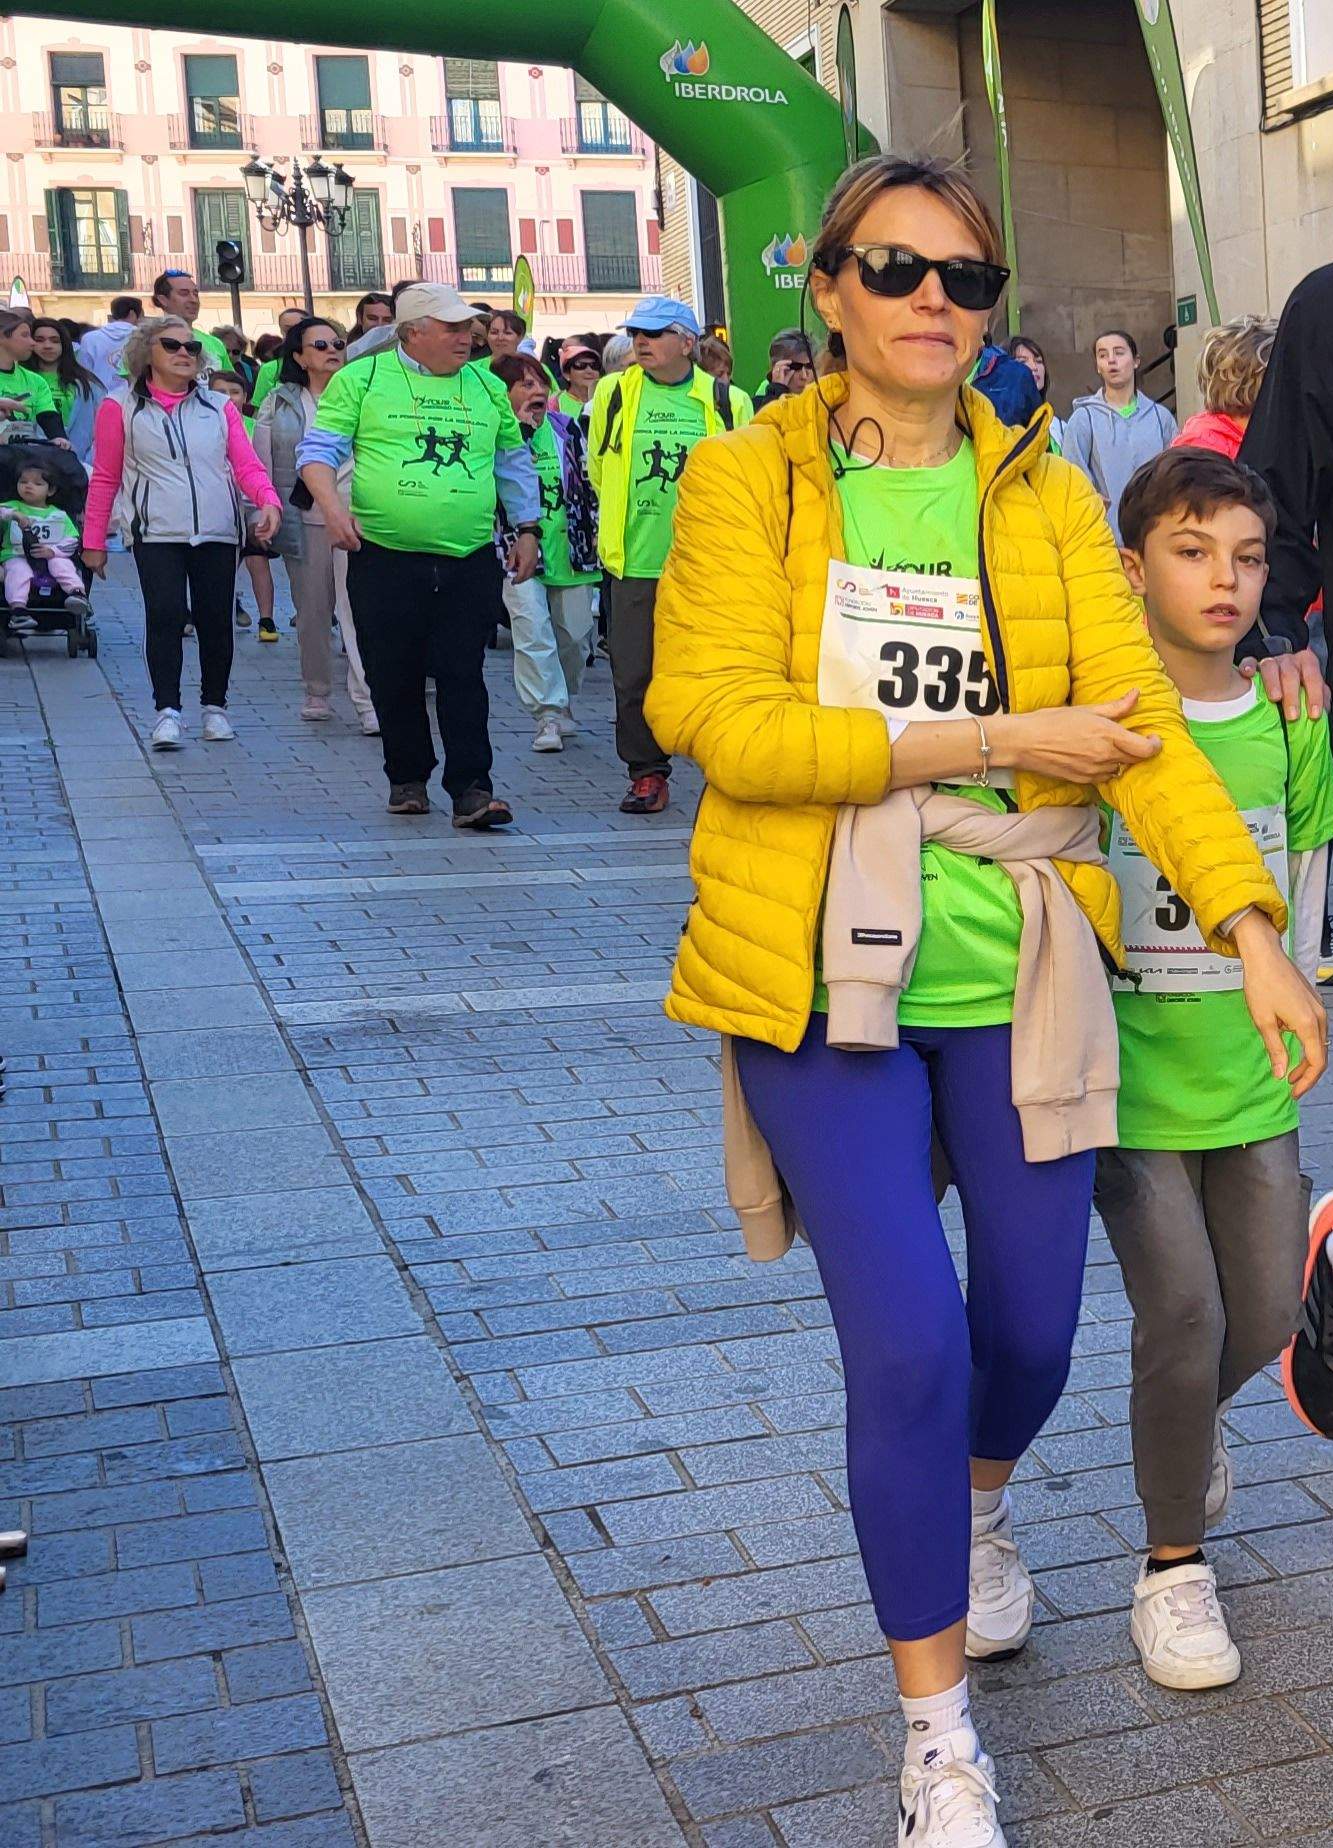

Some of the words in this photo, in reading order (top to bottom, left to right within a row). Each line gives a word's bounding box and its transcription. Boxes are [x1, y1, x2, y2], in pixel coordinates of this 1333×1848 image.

[674, 81, 789, 105] IBERDROLA
[877, 640, 1001, 717] 335
[1155, 874, 1191, 932] 3
